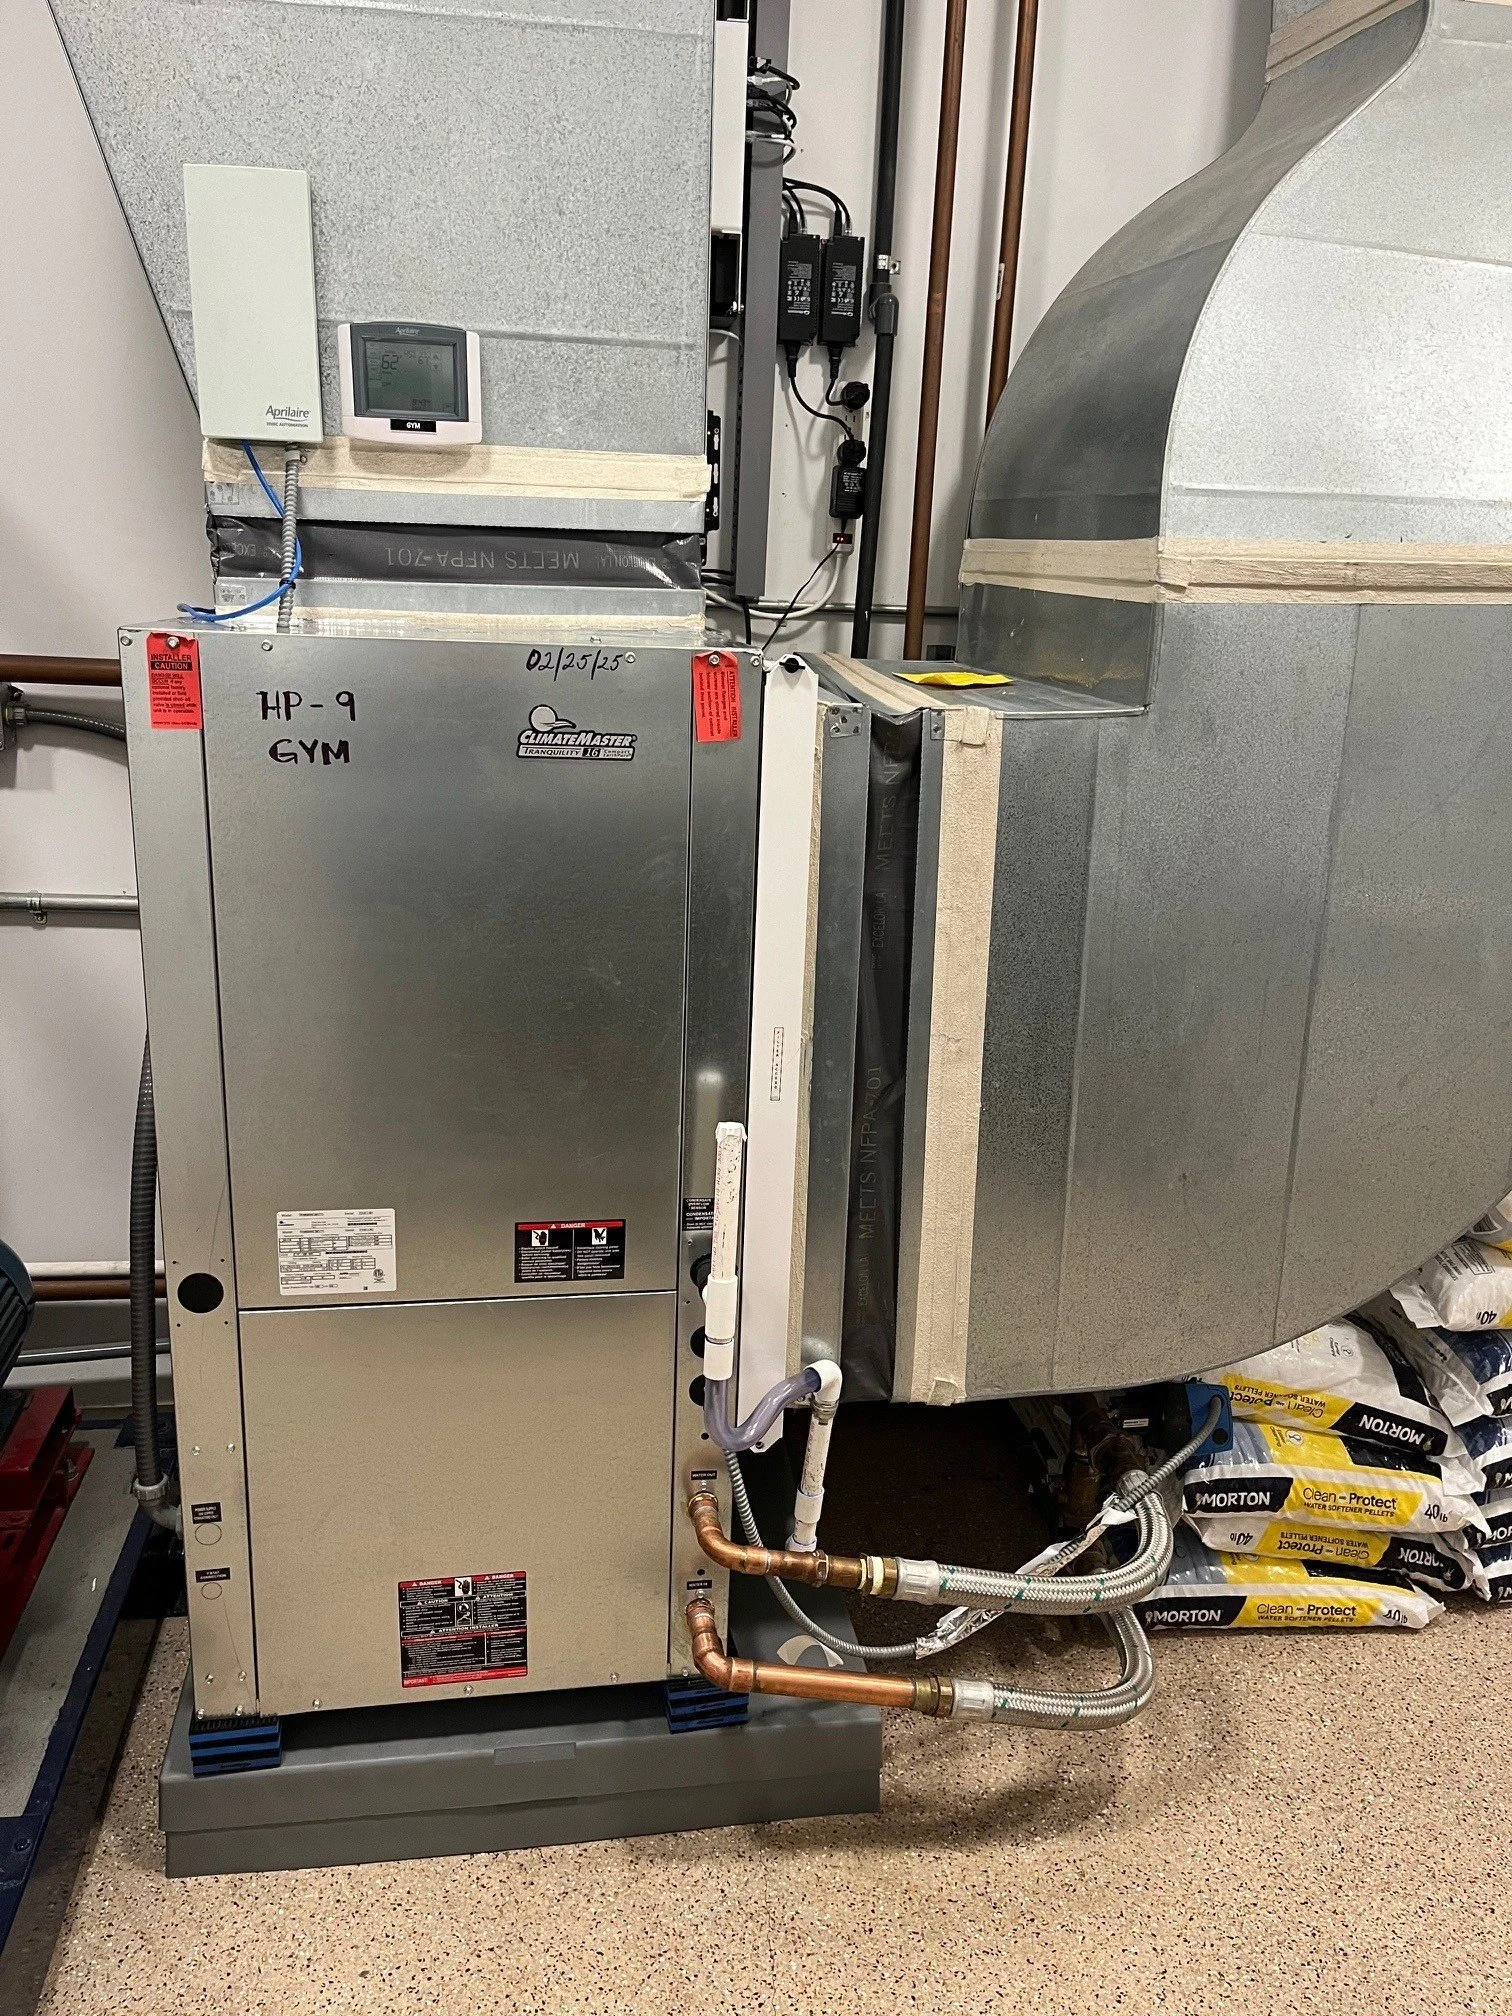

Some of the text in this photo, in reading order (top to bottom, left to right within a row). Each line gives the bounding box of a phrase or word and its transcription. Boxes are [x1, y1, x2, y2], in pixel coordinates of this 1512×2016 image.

[265, 405, 310, 419] Aprilaire
[387, 547, 495, 568] NFPA-701
[505, 550, 579, 569] MEETS
[154, 662, 188, 670] CAUTION
[526, 647, 623, 682] 02/25/25
[729, 671, 737, 702] ATTENTION
[269, 738, 350, 765] GYM
[524, 747, 600, 757] TRANQUILITY 16
[875, 795, 897, 872] MEETS
[1230, 1391, 1273, 1407] Potect
[1300, 1395, 1326, 1408] WATER
[1359, 1414, 1425, 1445] MORTON
[1201, 1491, 1271, 1508] MORTON
[1303, 1487, 1337, 1503] Clean
[1349, 1492, 1397, 1510] Protect
[1303, 1502, 1395, 1518] WATER SOFTENER PELLETS
[1277, 1540, 1324, 1555] Protect
[1280, 1531, 1369, 1548] WATER SOFTENER PELLETS
[1335, 1547, 1370, 1560] Clean
[1398, 1548, 1444, 1568] ORTON
[1153, 1609, 1221, 1623] MORTON
[1256, 1603, 1294, 1614] Clean
[1307, 1604, 1357, 1616] Protect
